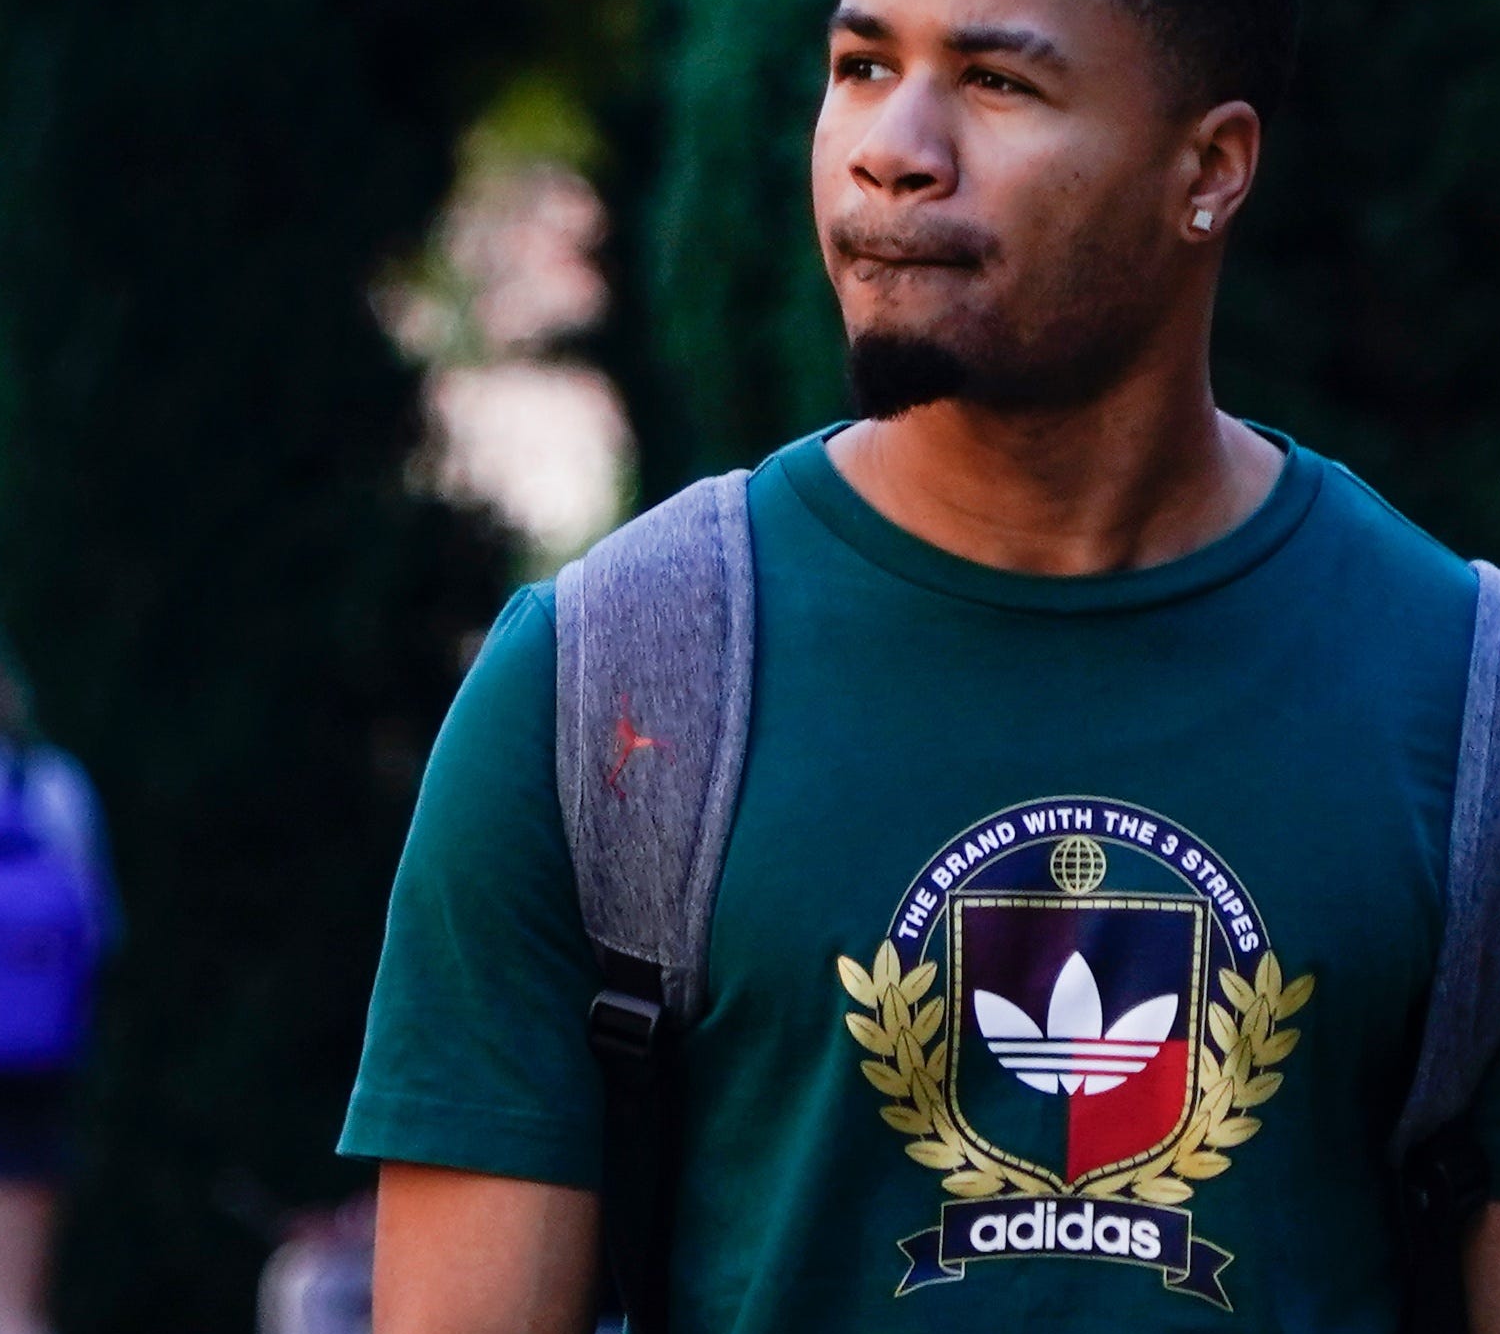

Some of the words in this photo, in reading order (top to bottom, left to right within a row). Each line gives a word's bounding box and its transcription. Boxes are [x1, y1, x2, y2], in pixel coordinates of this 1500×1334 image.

[898, 887, 938, 939] THE
[931, 821, 1016, 890] BRAND
[1022, 808, 1093, 835] WITH
[1103, 810, 1157, 845] THE
[1160, 834, 1179, 855] 3
[1181, 848, 1259, 953] STRIPES
[969, 1201, 1162, 1259] adidas
